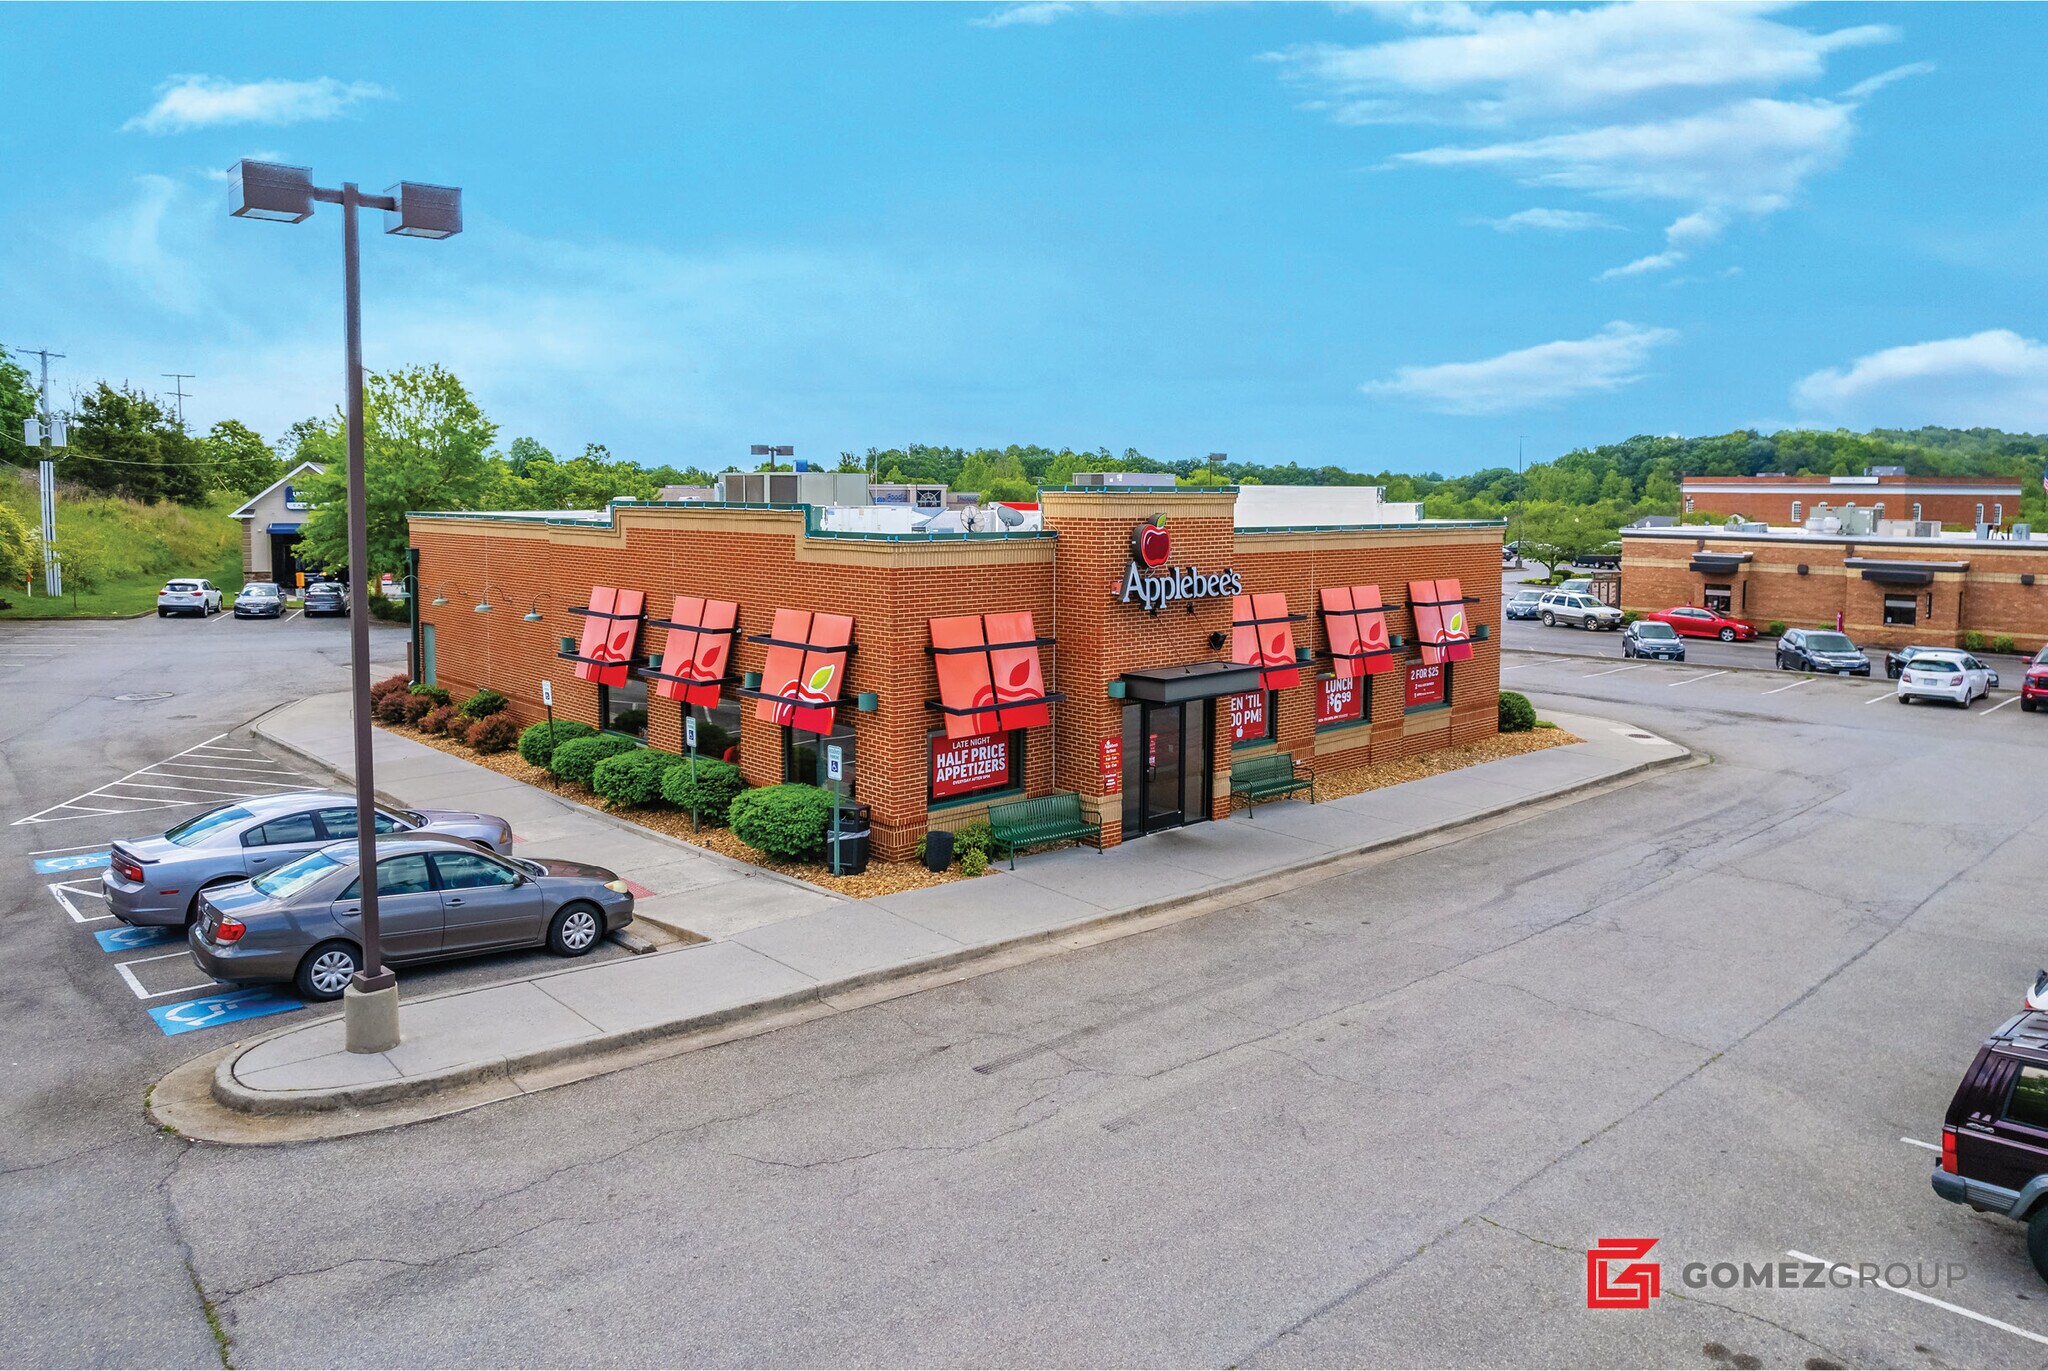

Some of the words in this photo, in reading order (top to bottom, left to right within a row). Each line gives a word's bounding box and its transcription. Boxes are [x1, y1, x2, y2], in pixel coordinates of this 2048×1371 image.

[1122, 561, 1243, 610] Applebee's
[1411, 670, 1415, 680] 2
[1415, 668, 1428, 679] FOR
[1428, 666, 1439, 678] $25
[1325, 677, 1353, 693] LUNCH
[952, 739, 969, 750] LATE
[970, 736, 991, 747] NIGHT
[936, 749, 969, 769] HALF
[971, 743, 1006, 762] PRICE
[936, 757, 1006, 783] APPETIZERS
